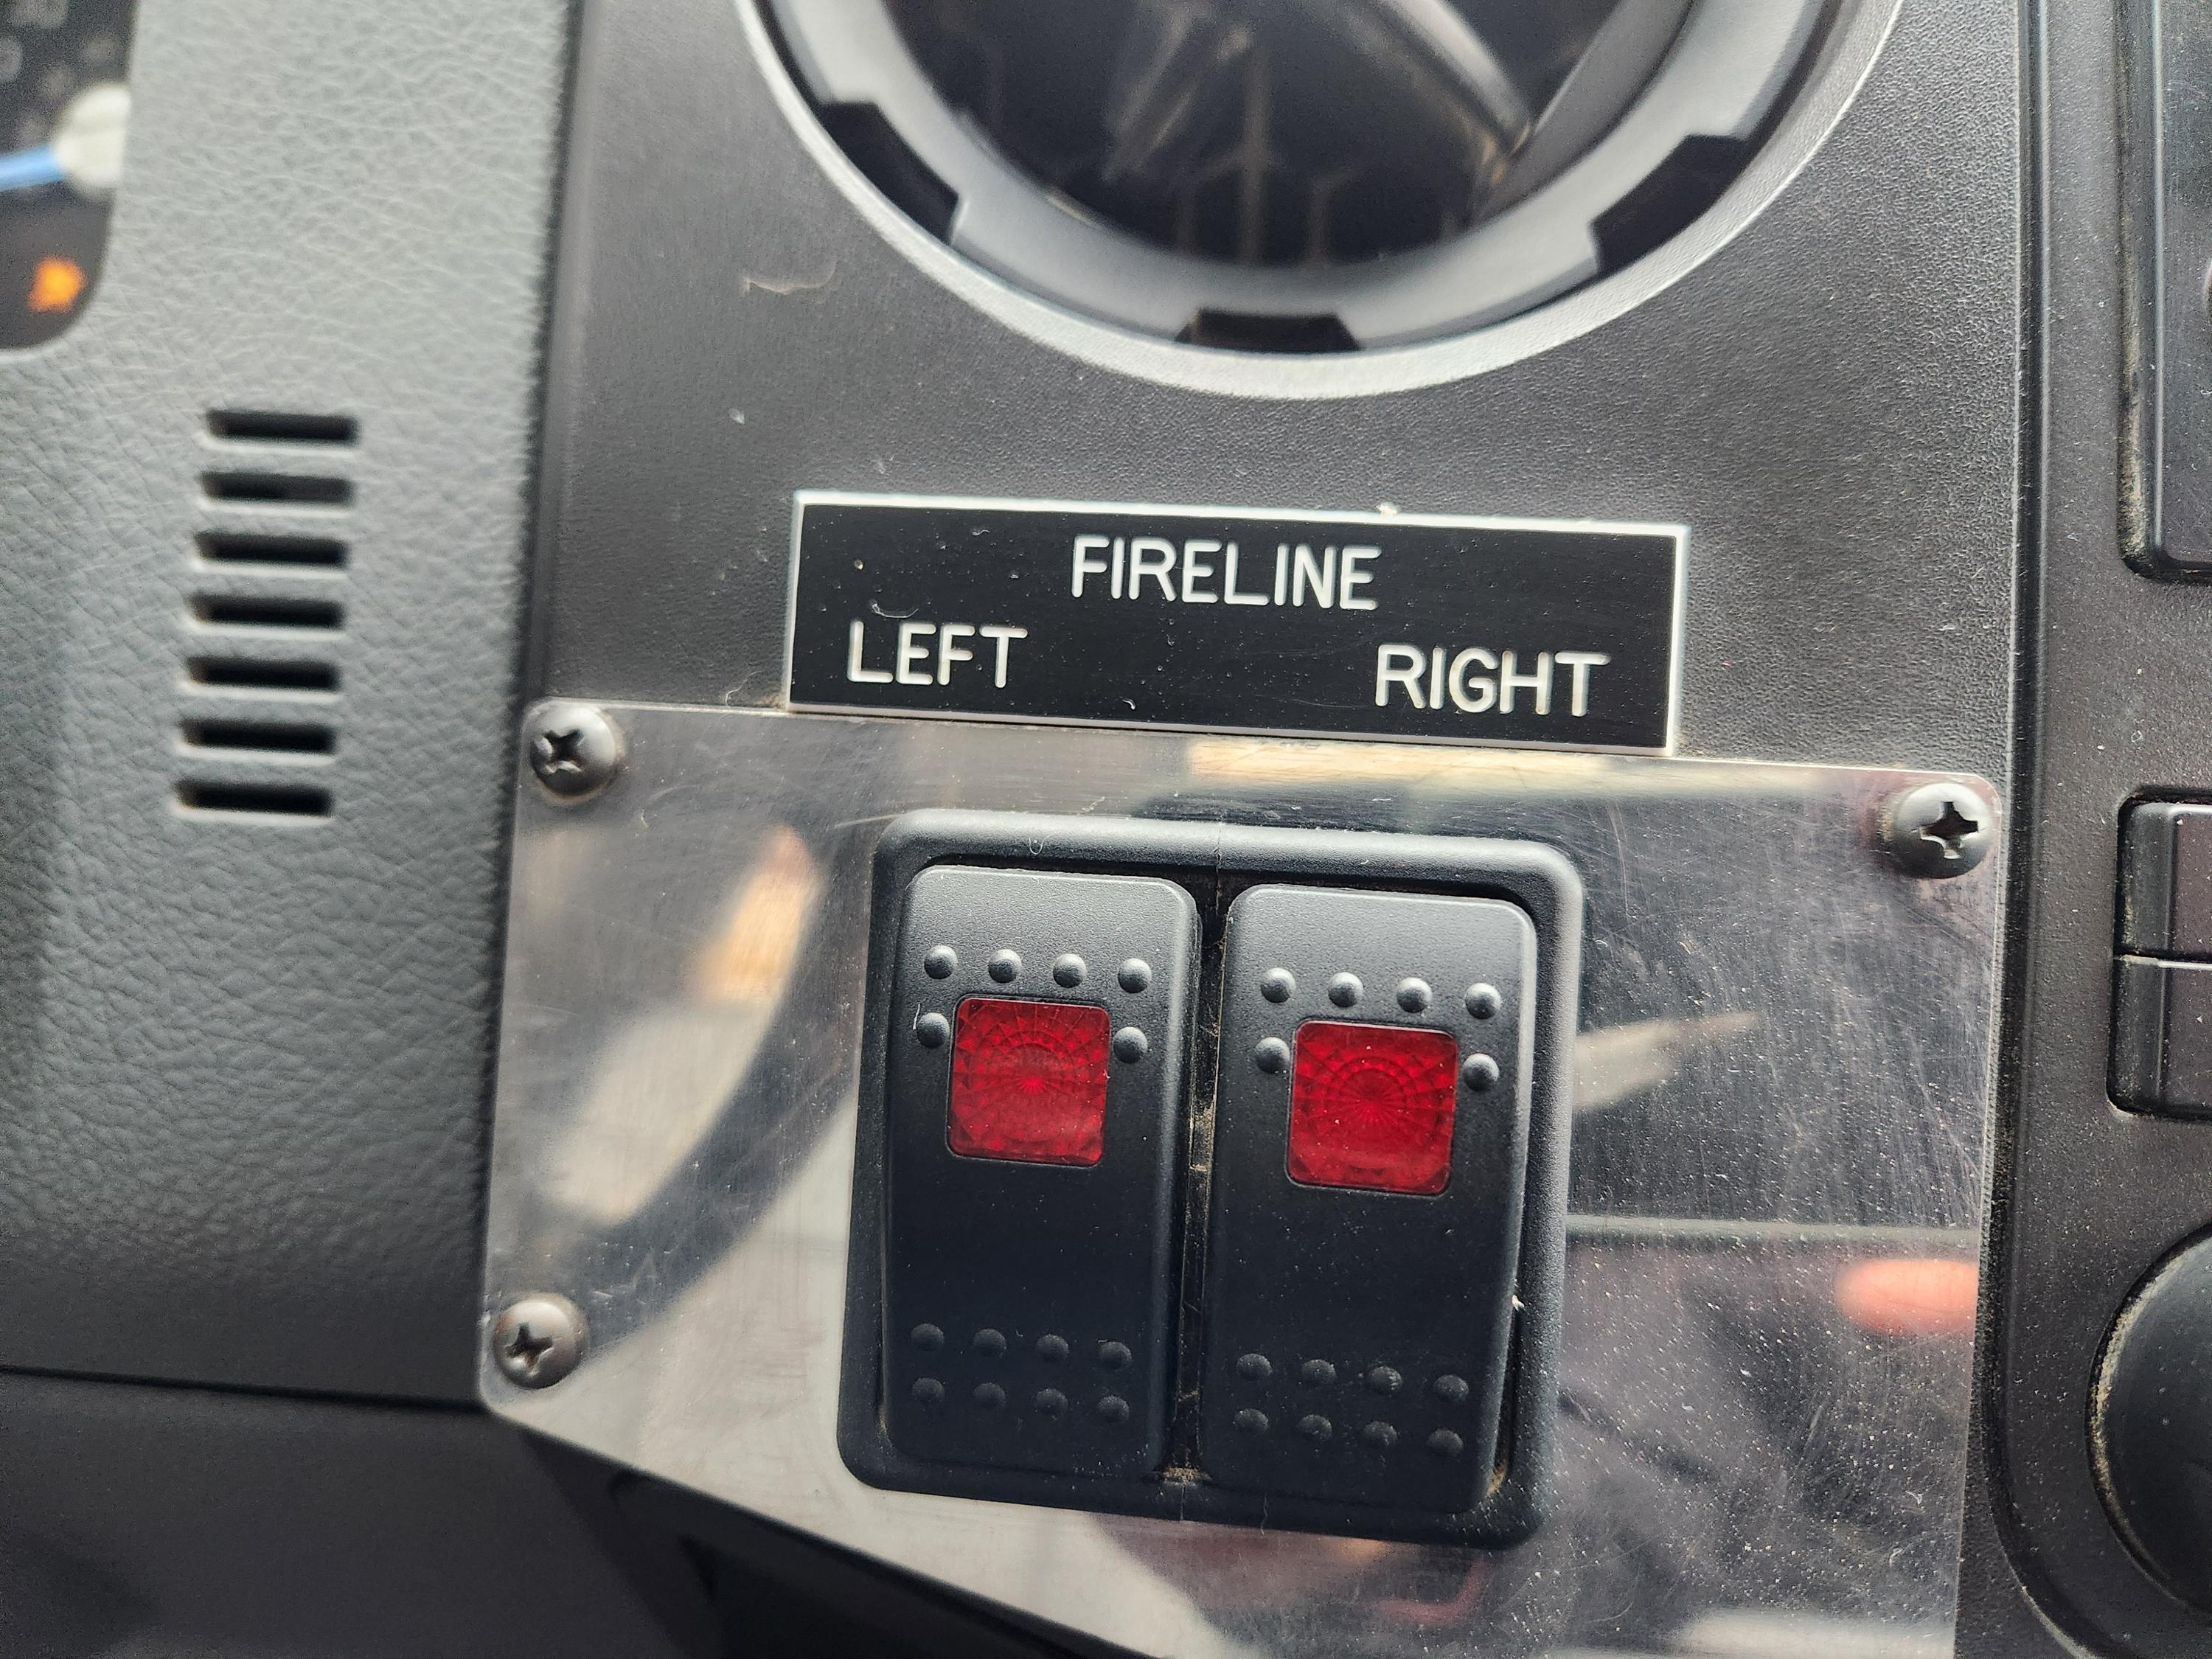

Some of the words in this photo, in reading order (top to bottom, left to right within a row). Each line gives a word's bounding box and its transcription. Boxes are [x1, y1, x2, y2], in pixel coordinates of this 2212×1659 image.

[1071, 535, 1382, 611] FIRELINE
[846, 621, 1029, 689] LEFT
[1374, 644, 1610, 717] RIGHT
